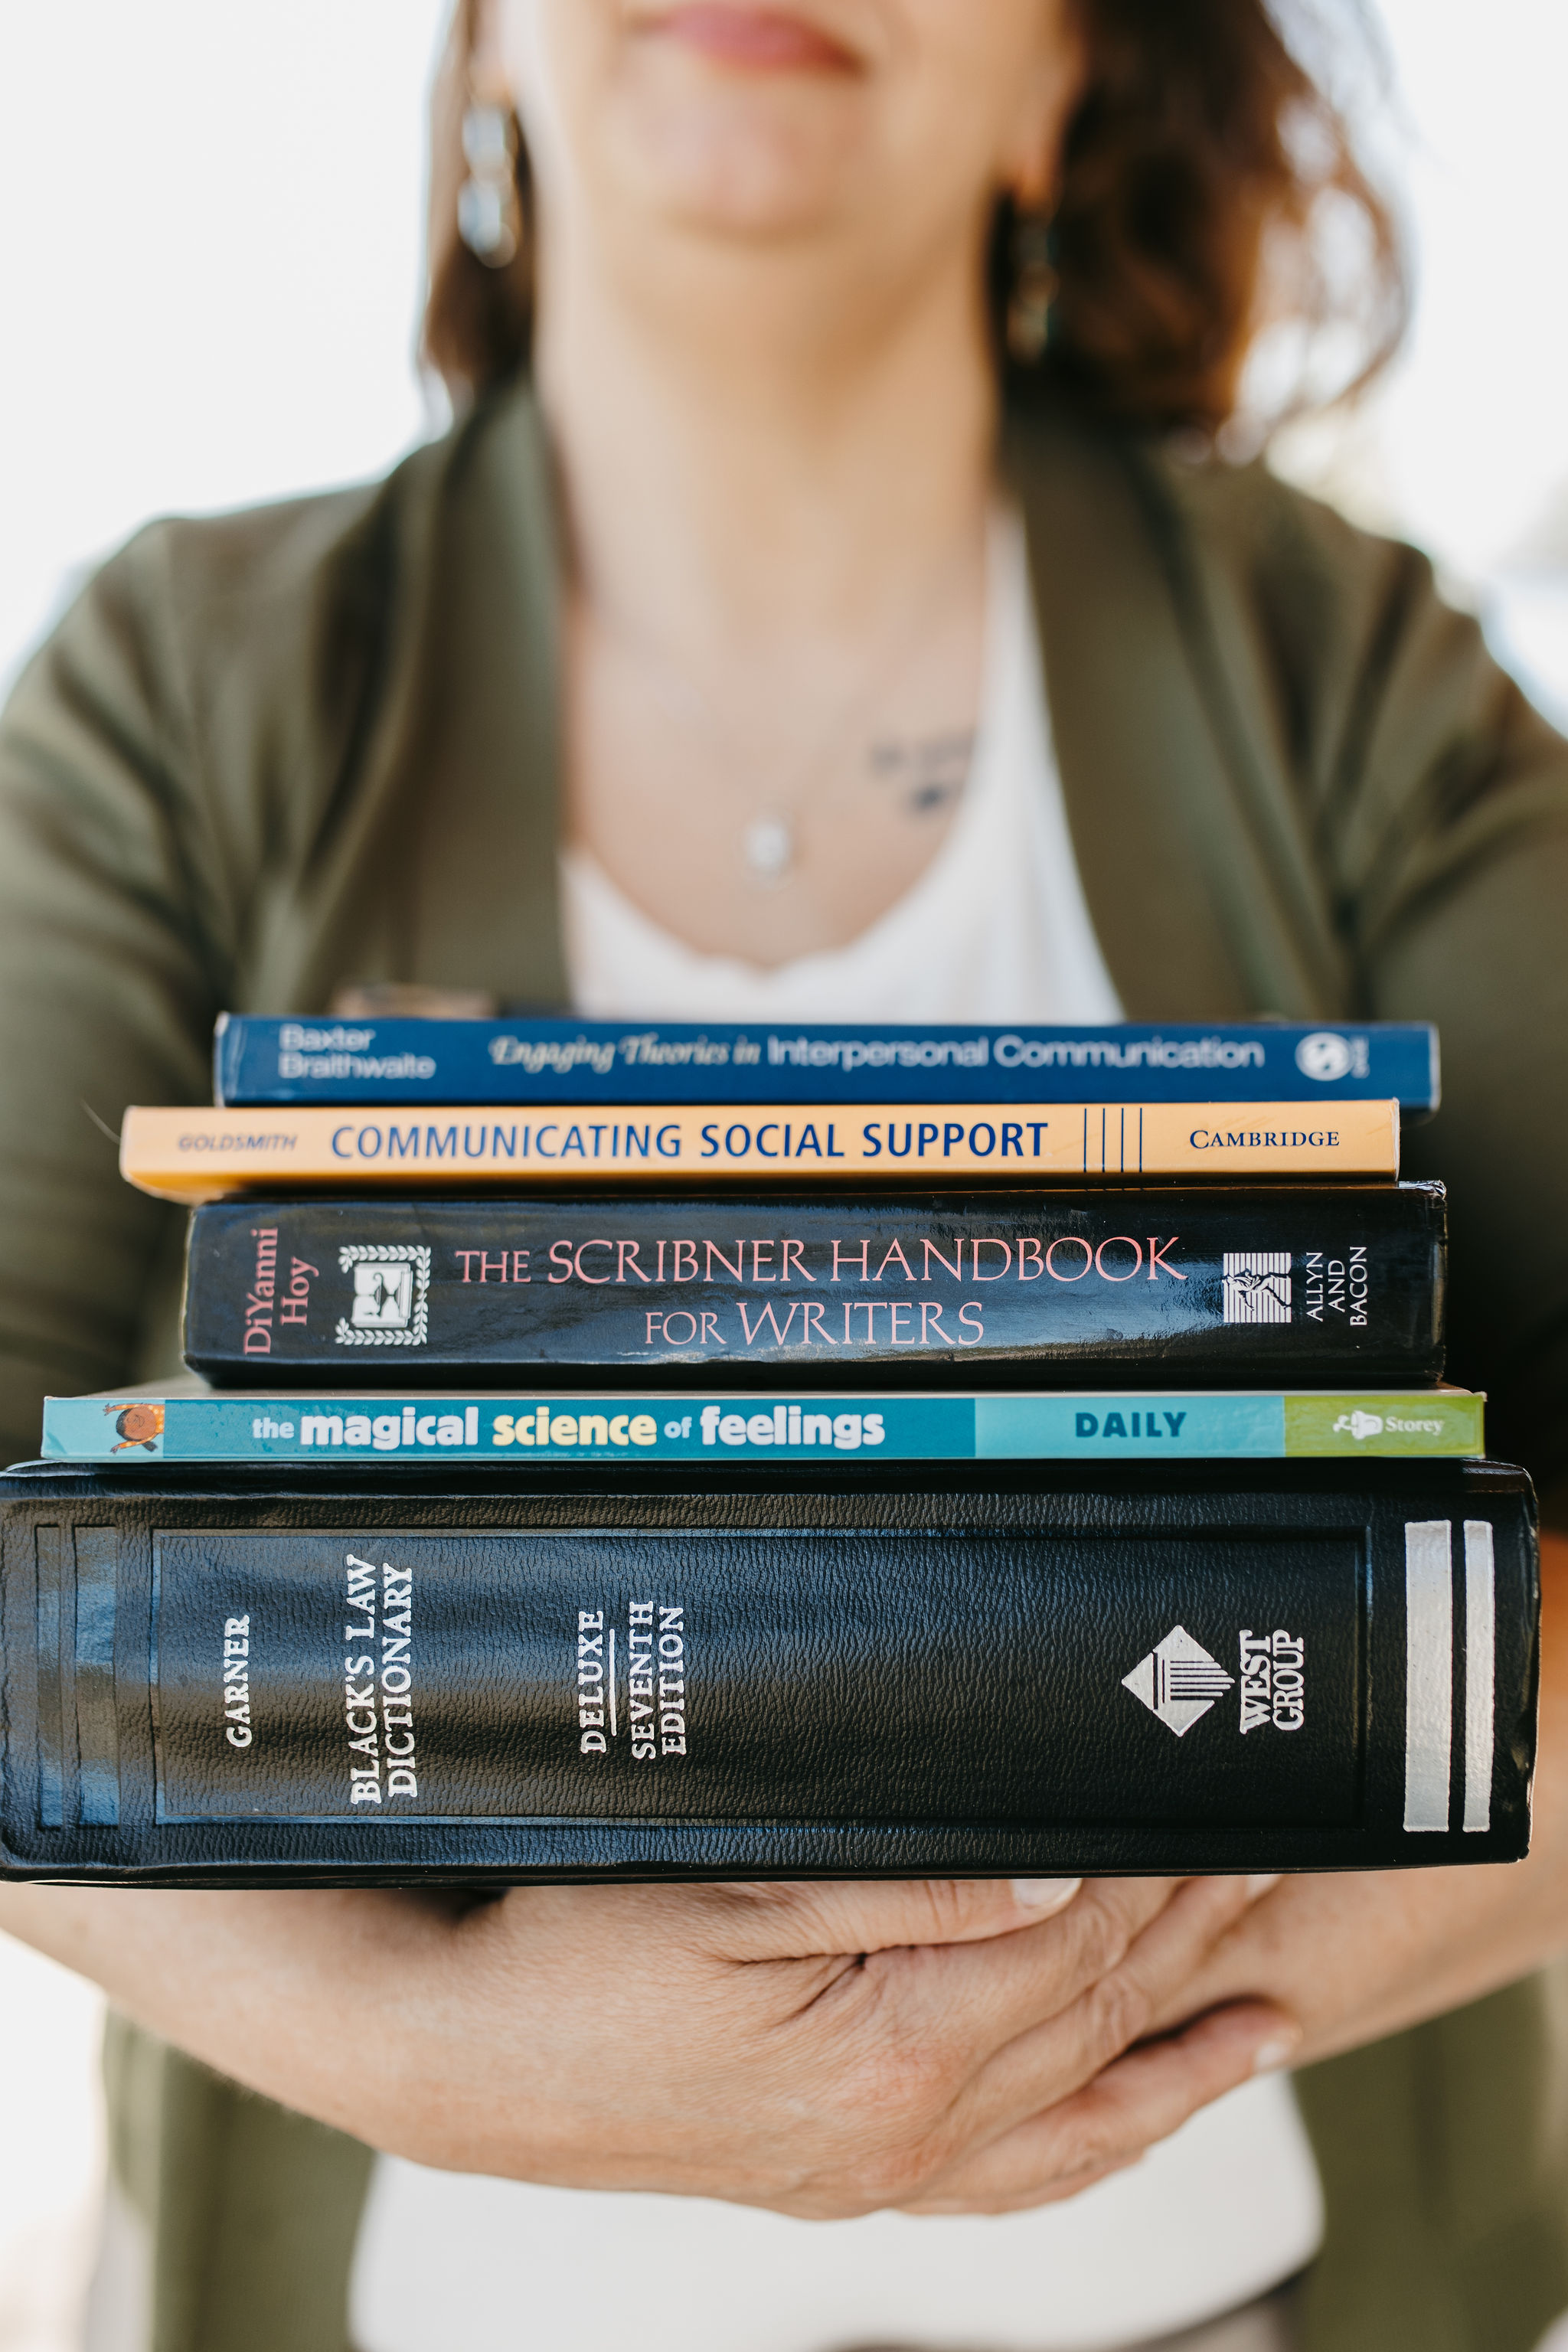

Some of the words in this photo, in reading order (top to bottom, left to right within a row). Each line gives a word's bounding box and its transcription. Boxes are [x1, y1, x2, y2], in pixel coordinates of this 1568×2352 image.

[278, 1052, 437, 1080] Braithwaite
[279, 1023, 376, 1052] Baxter
[488, 1034, 615, 1074] Engaging
[619, 1032, 729, 1067] Theories
[733, 1035, 762, 1067] in
[766, 1034, 989, 1072] Interpersonal
[994, 1034, 1265, 1069] Communication
[178, 1133, 297, 1152] GOLDSMITH
[332, 1125, 681, 1158] COMMUNICATING
[701, 1123, 844, 1158] SOCIAL
[862, 1122, 1048, 1157] SUPPORT
[243, 1227, 278, 1355] DiYanni
[280, 1256, 319, 1326] Hoy
[455, 1250, 531, 1283] THE
[548, 1239, 817, 1284] SCRIBNER
[831, 1236, 1189, 1282] HANDBOOK
[1306, 1252, 1323, 1322] ALLYN
[1328, 1259, 1345, 1313] AND
[1350, 1246, 1368, 1326] BACON
[645, 1311, 727, 1345] FOR
[737, 1301, 985, 1347] WRITERS
[253, 1418, 294, 1439] the
[301, 1406, 479, 1449] magical
[492, 1406, 657, 1446] science
[665, 1417, 691, 1439] of
[700, 1406, 886, 1450] feelings
[1075, 1412, 1187, 1438] DAILY
[1386, 1416, 1446, 1436] Storey
[345, 1554, 376, 1640] LAW
[224, 1615, 252, 1748] GARNER
[381, 1563, 418, 1798] DICTIONARY
[578, 1610, 607, 1753] DELUXE
[629, 1600, 656, 1760] SEVENTH
[658, 1606, 686, 1756] EDITION
[1240, 1629, 1271, 1735] WEST
[1272, 1629, 1304, 1731] GROUP
[345, 1655, 382, 1805] BLACK'S
